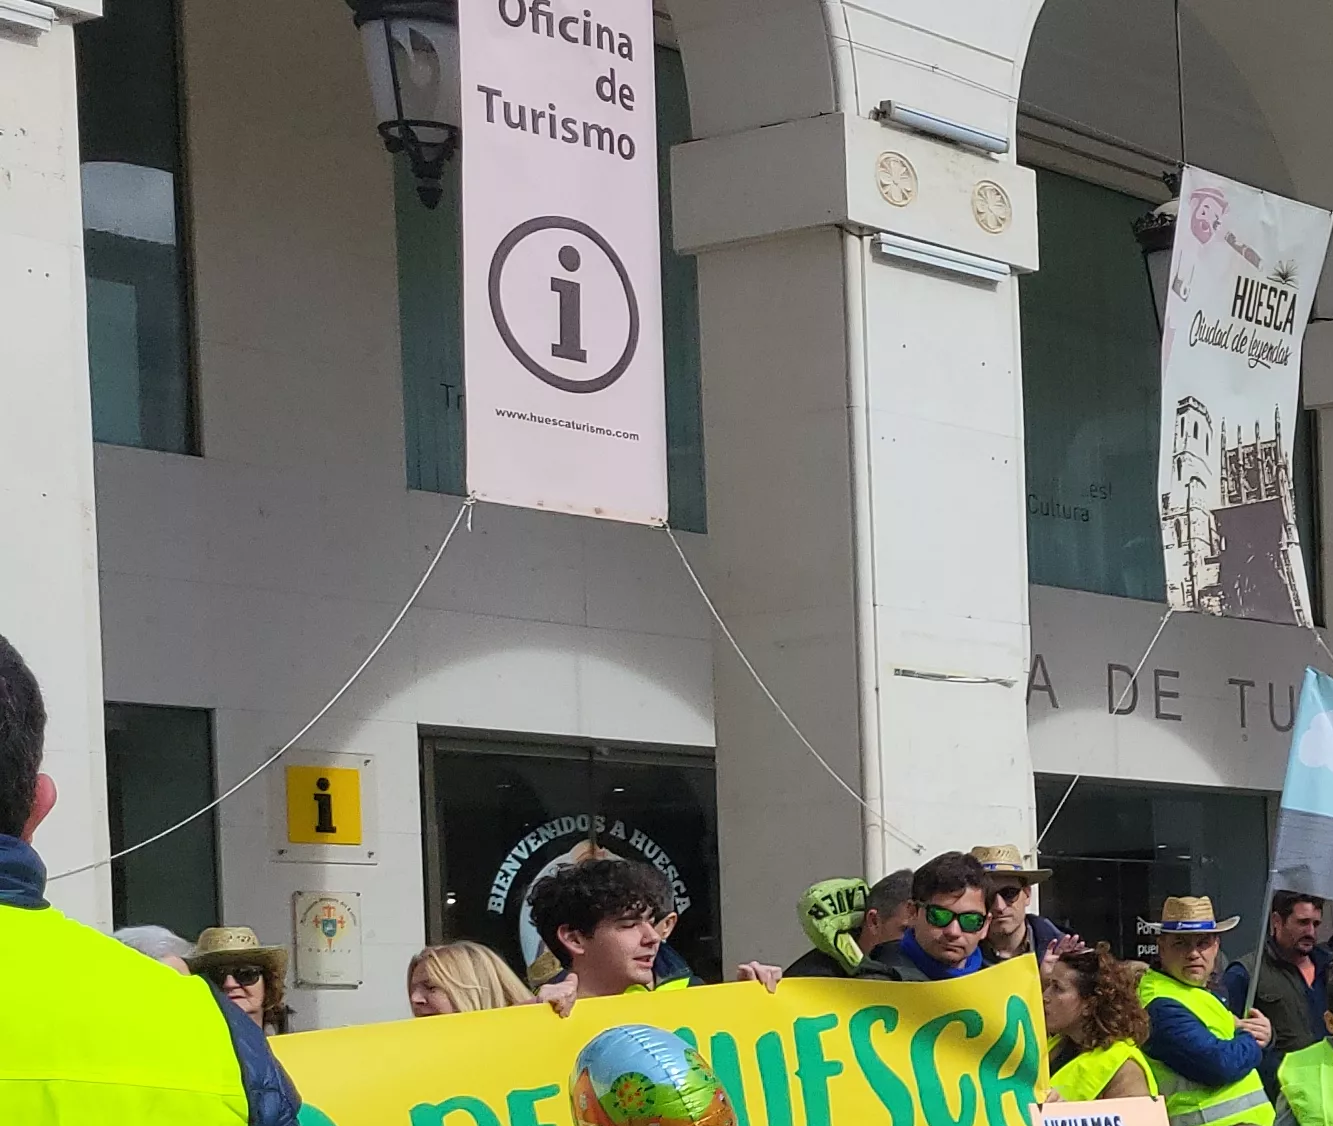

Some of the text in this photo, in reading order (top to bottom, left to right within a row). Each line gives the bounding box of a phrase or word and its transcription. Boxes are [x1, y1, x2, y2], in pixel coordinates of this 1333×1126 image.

[498, 0, 634, 61] Oficina
[595, 67, 635, 111] de
[477, 84, 636, 161] Turismo
[1231, 275, 1297, 335] HUESCA
[1189, 309, 1293, 369] Ciudad de leyendas
[495, 406, 640, 441] www.huescaturismo.com
[1028, 493, 1090, 522] Cultura
[1107, 662, 1182, 722] DE
[487, 814, 692, 915] BIENVENIDOS A HUESCA
